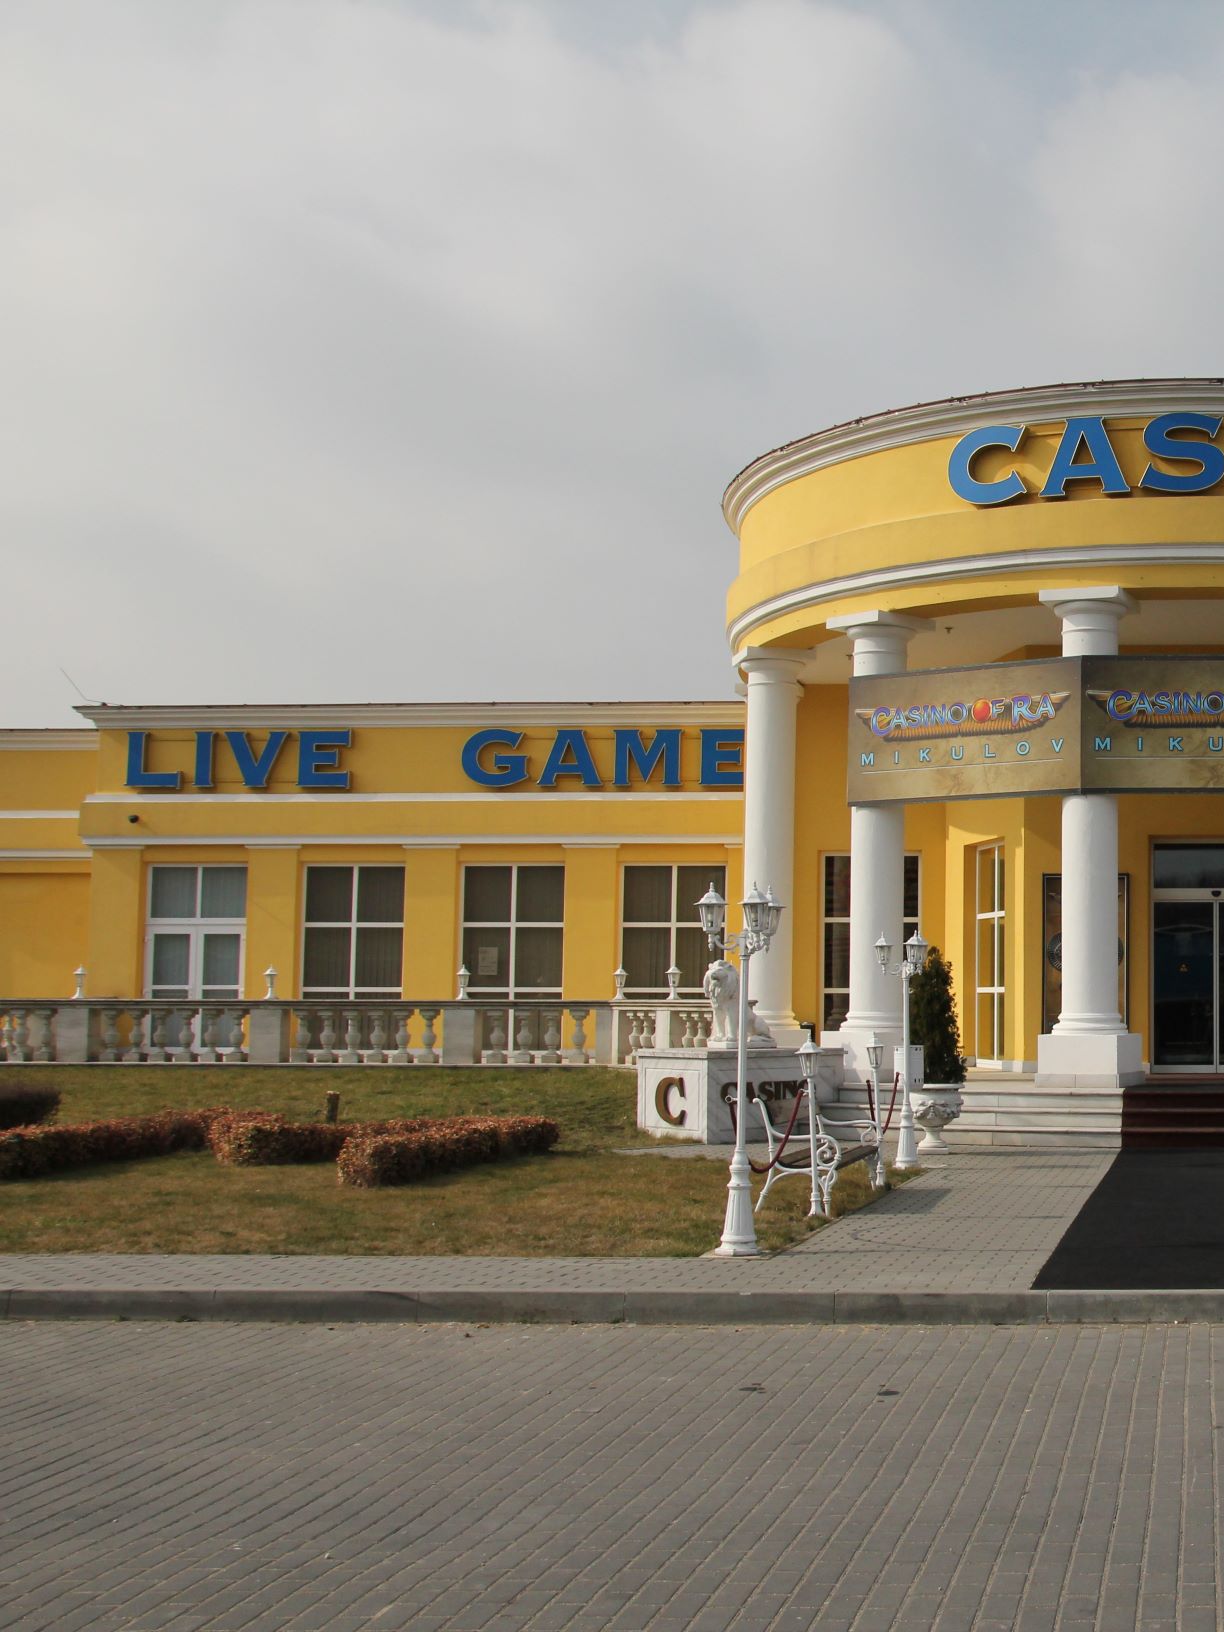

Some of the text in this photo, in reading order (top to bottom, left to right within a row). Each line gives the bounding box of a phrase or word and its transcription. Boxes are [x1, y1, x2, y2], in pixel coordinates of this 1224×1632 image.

[871, 692, 1056, 736] CASINO OF RA
[124, 728, 745, 789] LIVE GAME
[861, 738, 1064, 766] MIKULOV
[655, 1076, 686, 1126] C
